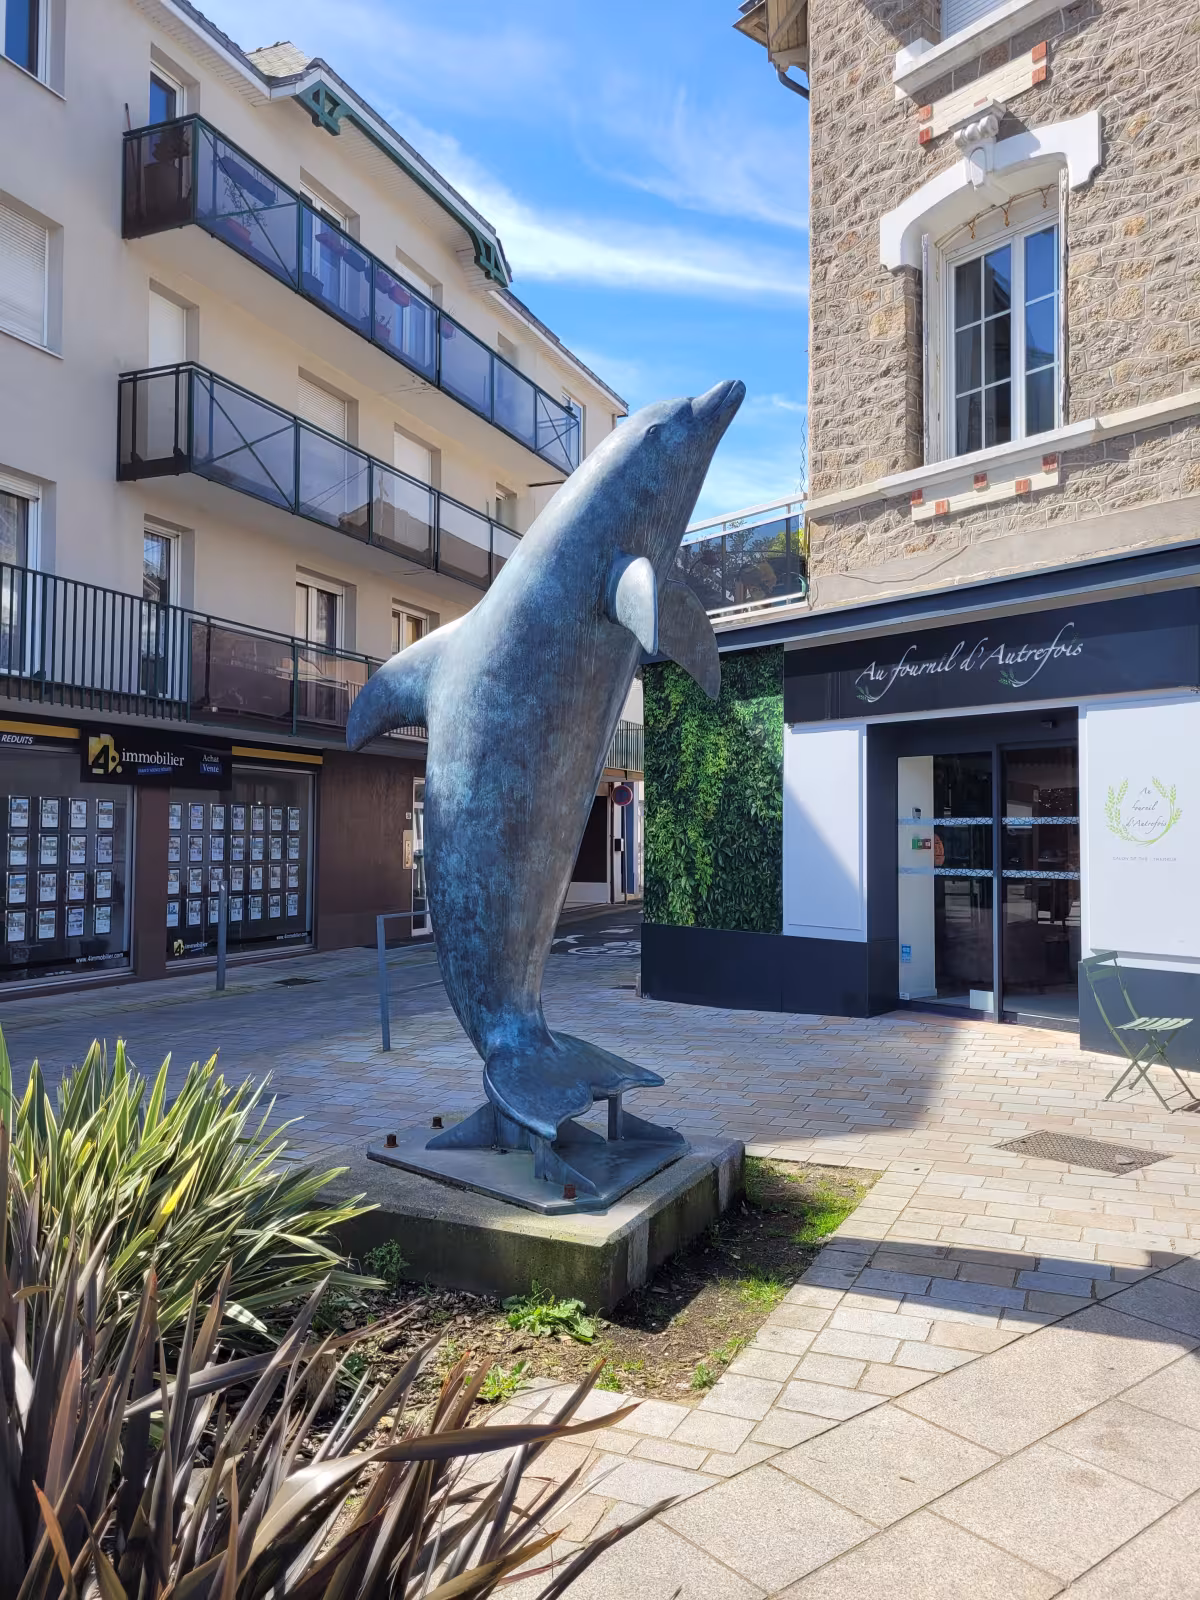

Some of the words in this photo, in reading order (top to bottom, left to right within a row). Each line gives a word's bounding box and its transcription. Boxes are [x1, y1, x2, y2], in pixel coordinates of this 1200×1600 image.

[960, 621, 1084, 688] d'Autrefois
[854, 660, 888, 685] Au
[868, 640, 965, 703] fournil
[1, 734, 34, 745] REDUITS
[121, 747, 185, 767] immobilier
[202, 754, 220, 763] Achat
[202, 763, 220, 773] Vente
